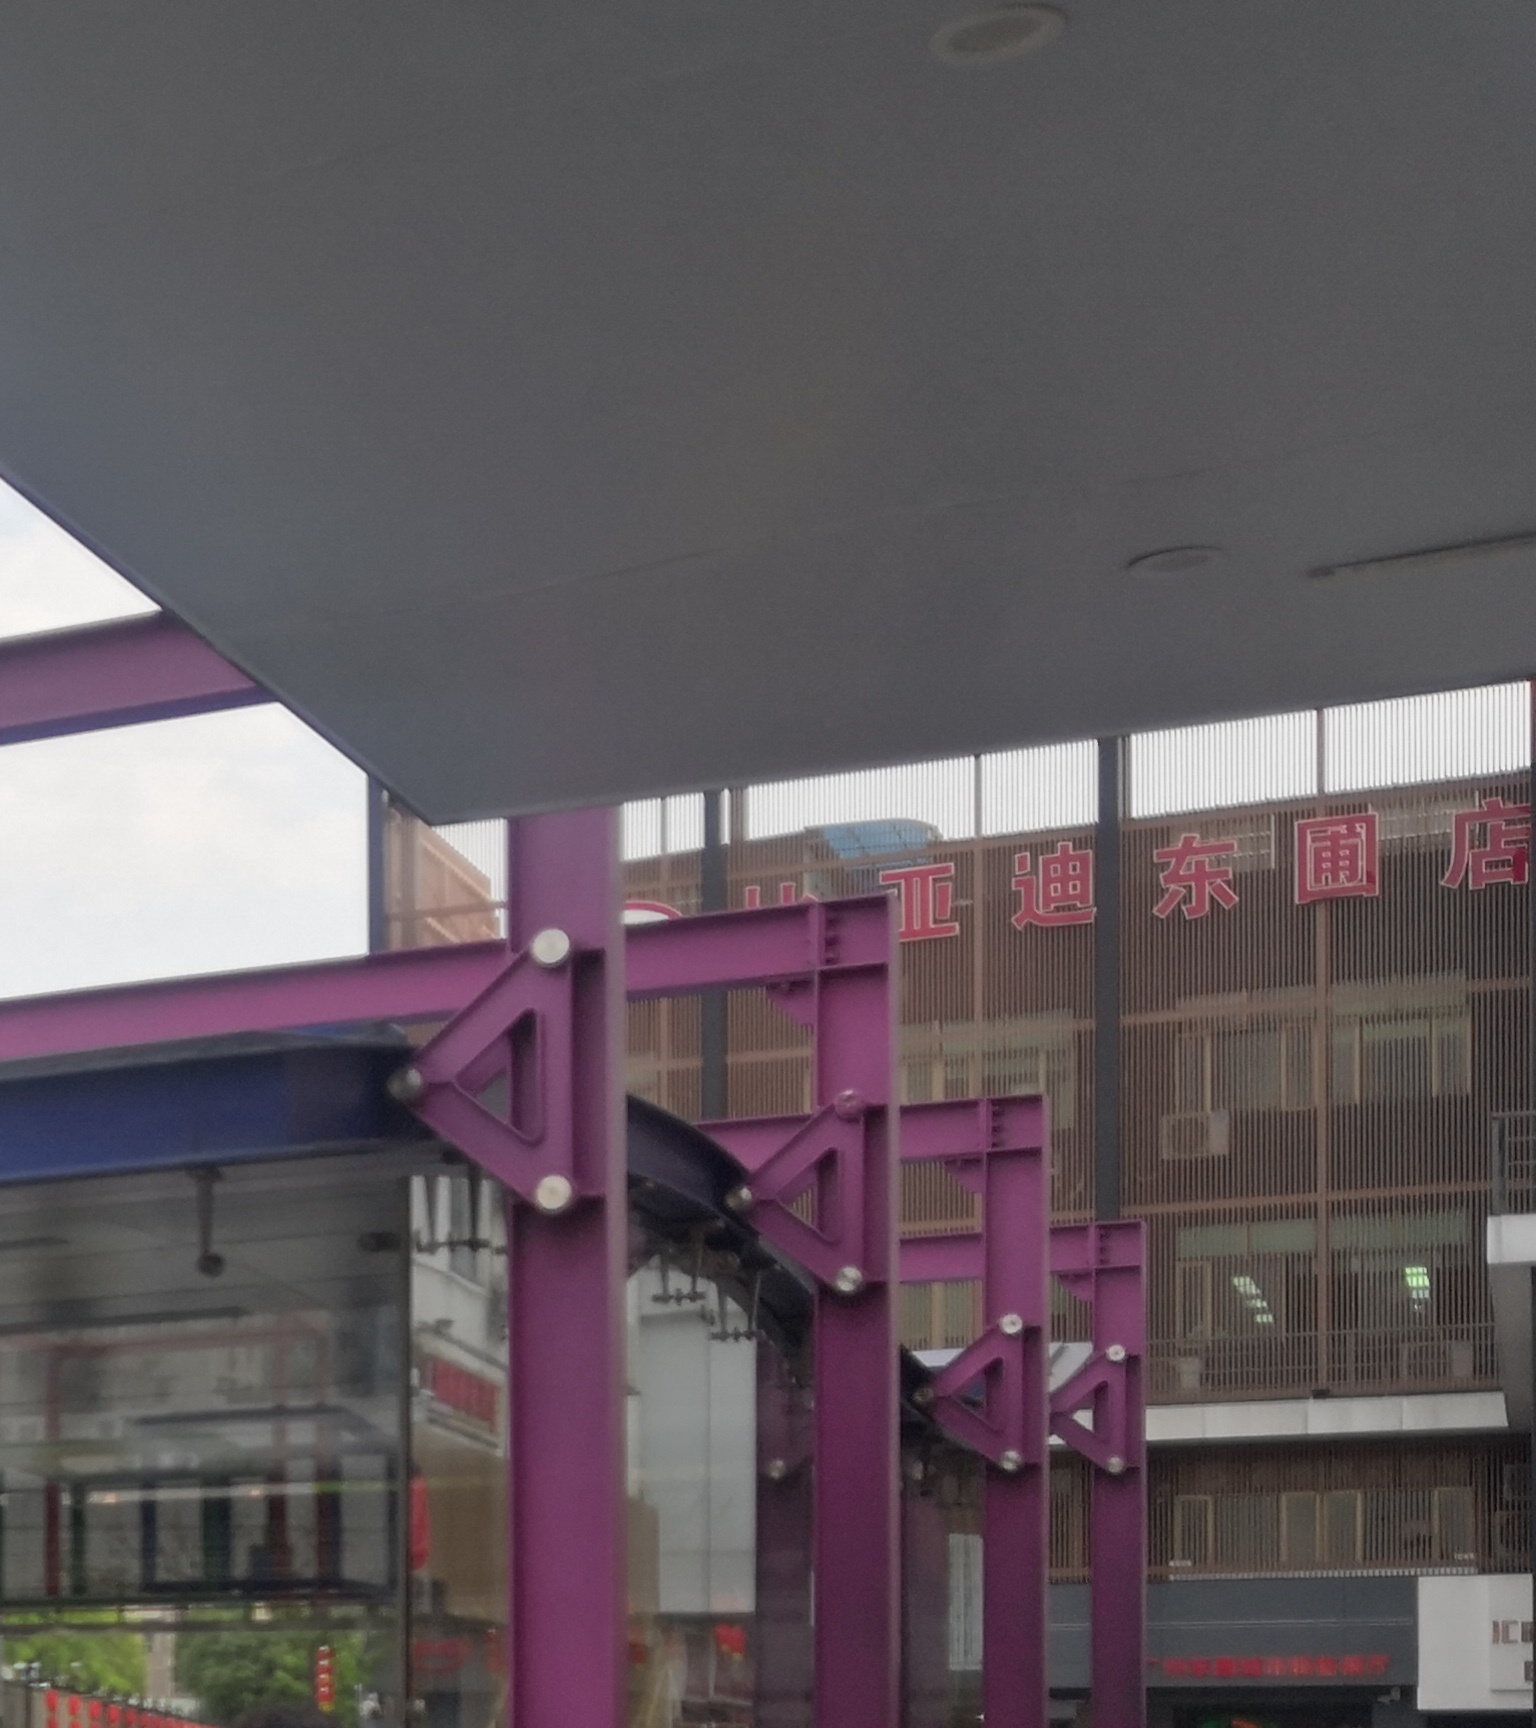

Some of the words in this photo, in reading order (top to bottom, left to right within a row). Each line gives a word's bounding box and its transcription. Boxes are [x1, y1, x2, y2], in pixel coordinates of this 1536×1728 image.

[745, 797, 1532, 943] 亚迪东圃店
